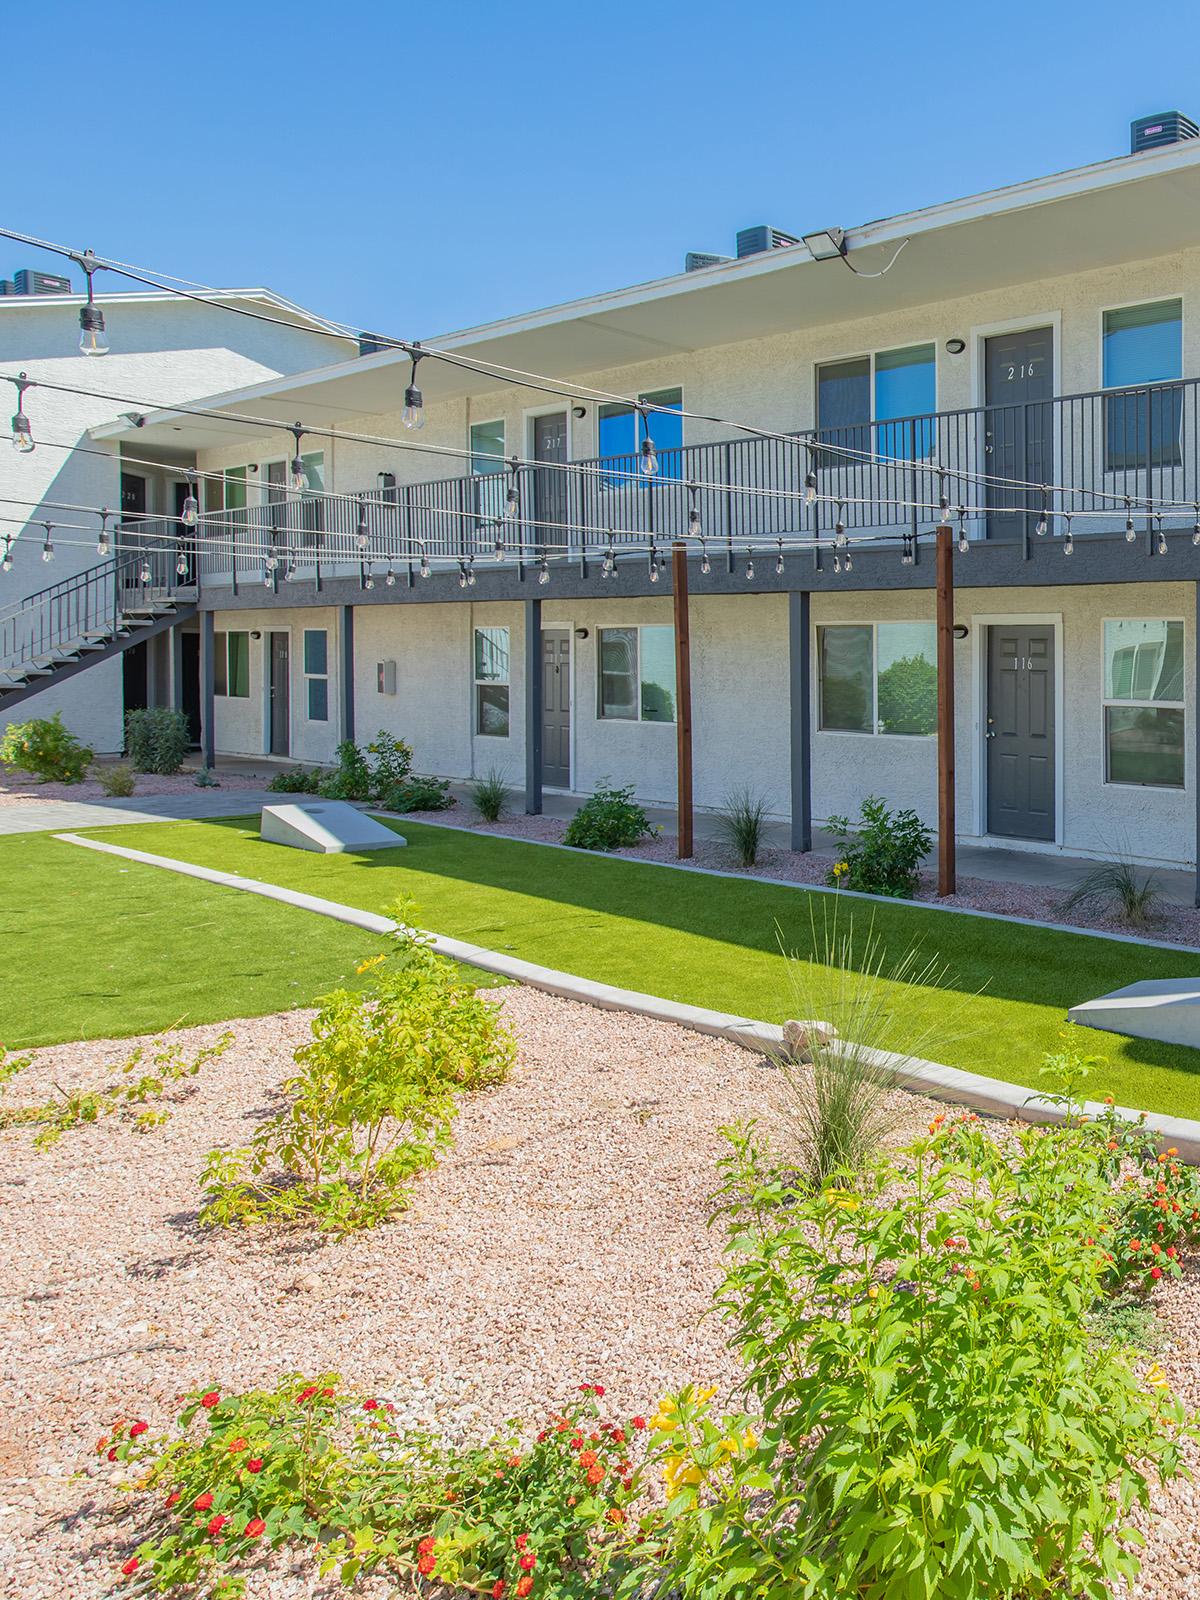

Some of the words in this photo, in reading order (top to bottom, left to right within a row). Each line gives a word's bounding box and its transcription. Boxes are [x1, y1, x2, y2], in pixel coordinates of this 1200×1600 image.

[1007, 363, 1034, 380] 216
[546, 437, 561, 449] 217
[1013, 657, 1033, 670] 116
